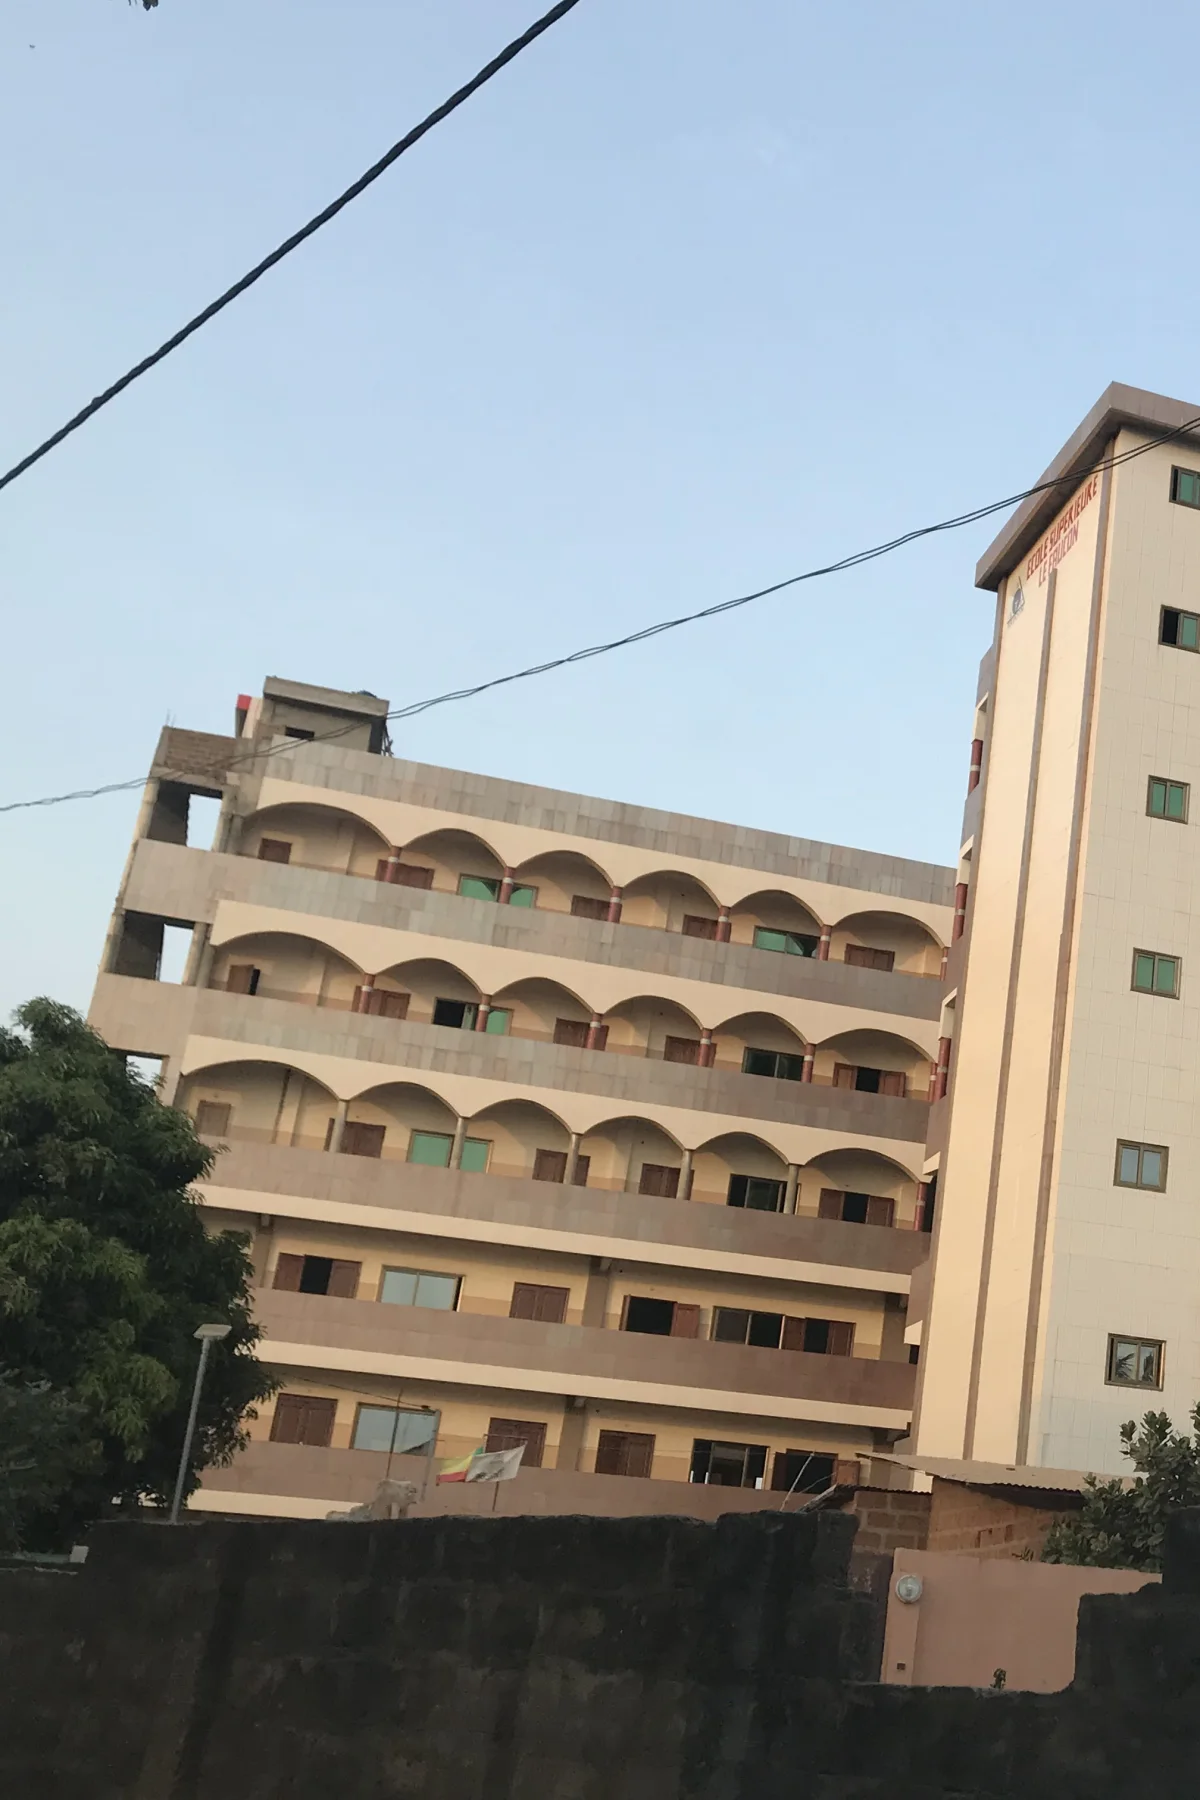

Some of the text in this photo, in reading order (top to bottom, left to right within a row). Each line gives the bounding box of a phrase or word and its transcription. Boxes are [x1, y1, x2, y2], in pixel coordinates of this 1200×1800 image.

[1026, 474, 1099, 580] ECOLE SUPERIEURE
[1038, 560, 1048, 588] LE
